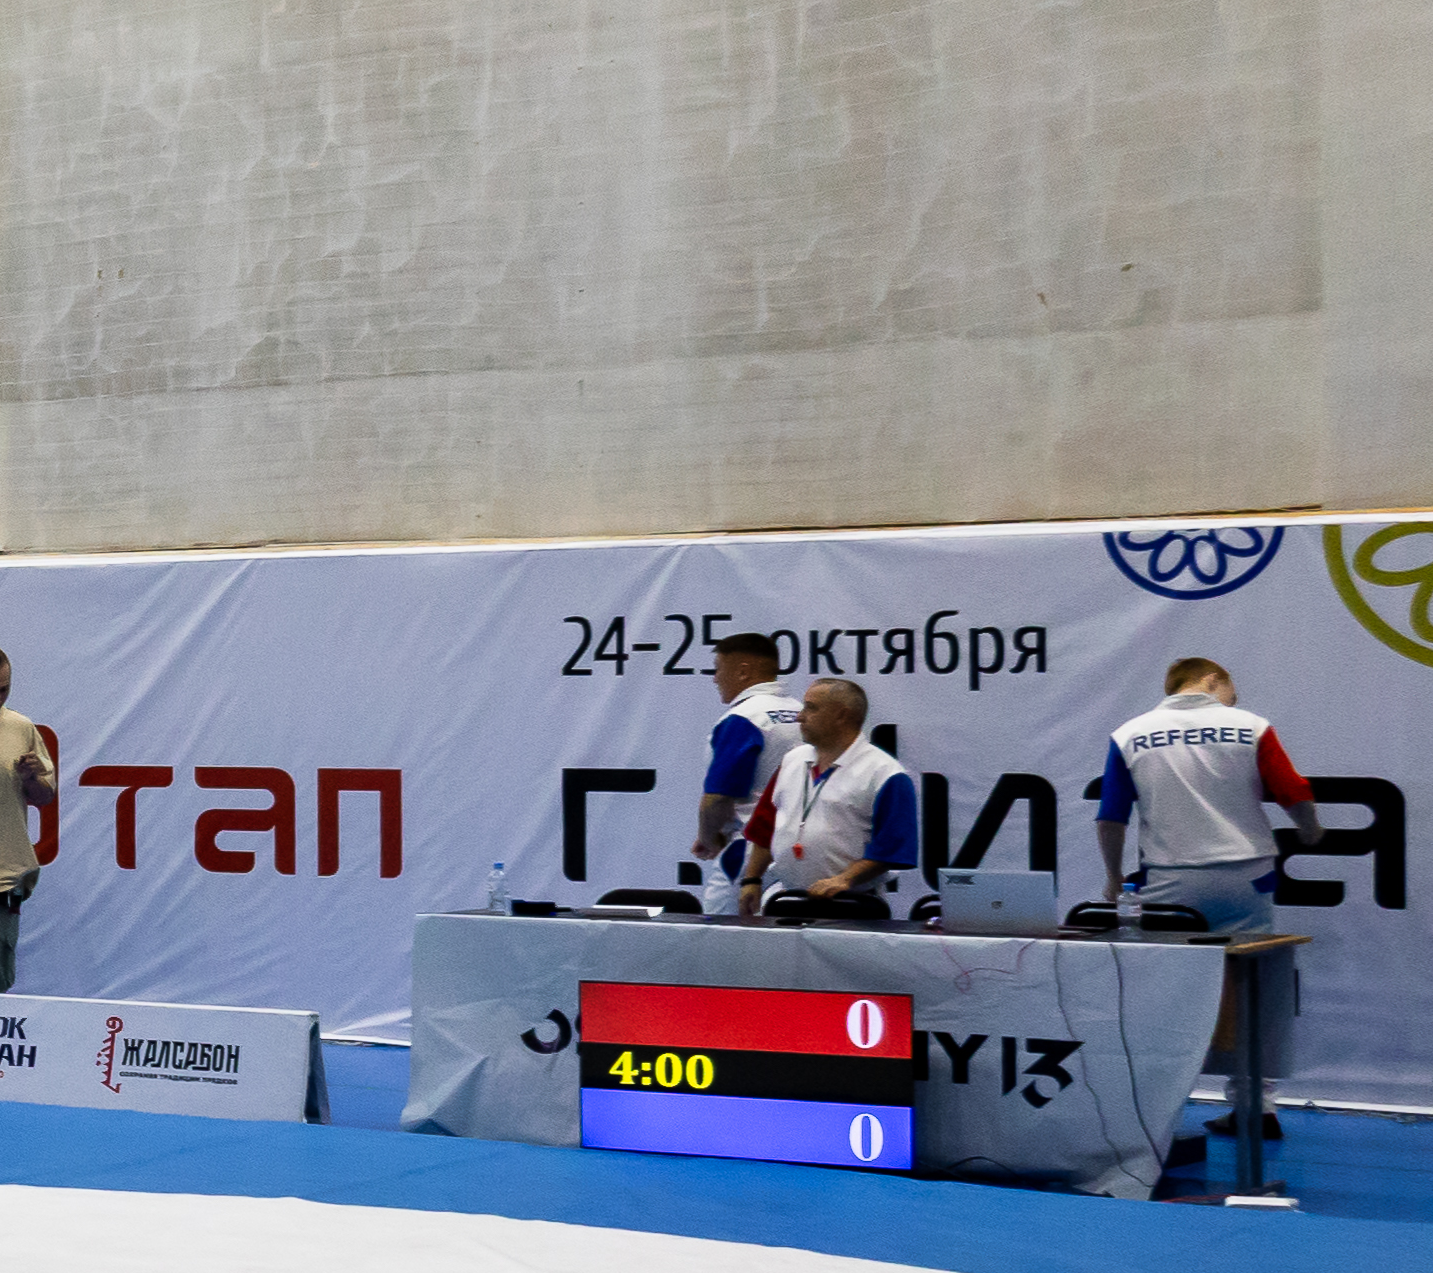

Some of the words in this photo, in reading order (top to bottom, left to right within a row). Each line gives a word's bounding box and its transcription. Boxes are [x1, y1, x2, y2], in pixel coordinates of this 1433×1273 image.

[768, 609, 1049, 692] октября
[1131, 724, 1255, 754] REFEREE
[846, 999, 885, 1050] 0
[121, 1038, 240, 1073] ЖАЛСАБОН
[608, 1051, 714, 1089] 4:00
[849, 1112, 884, 1162] 0
